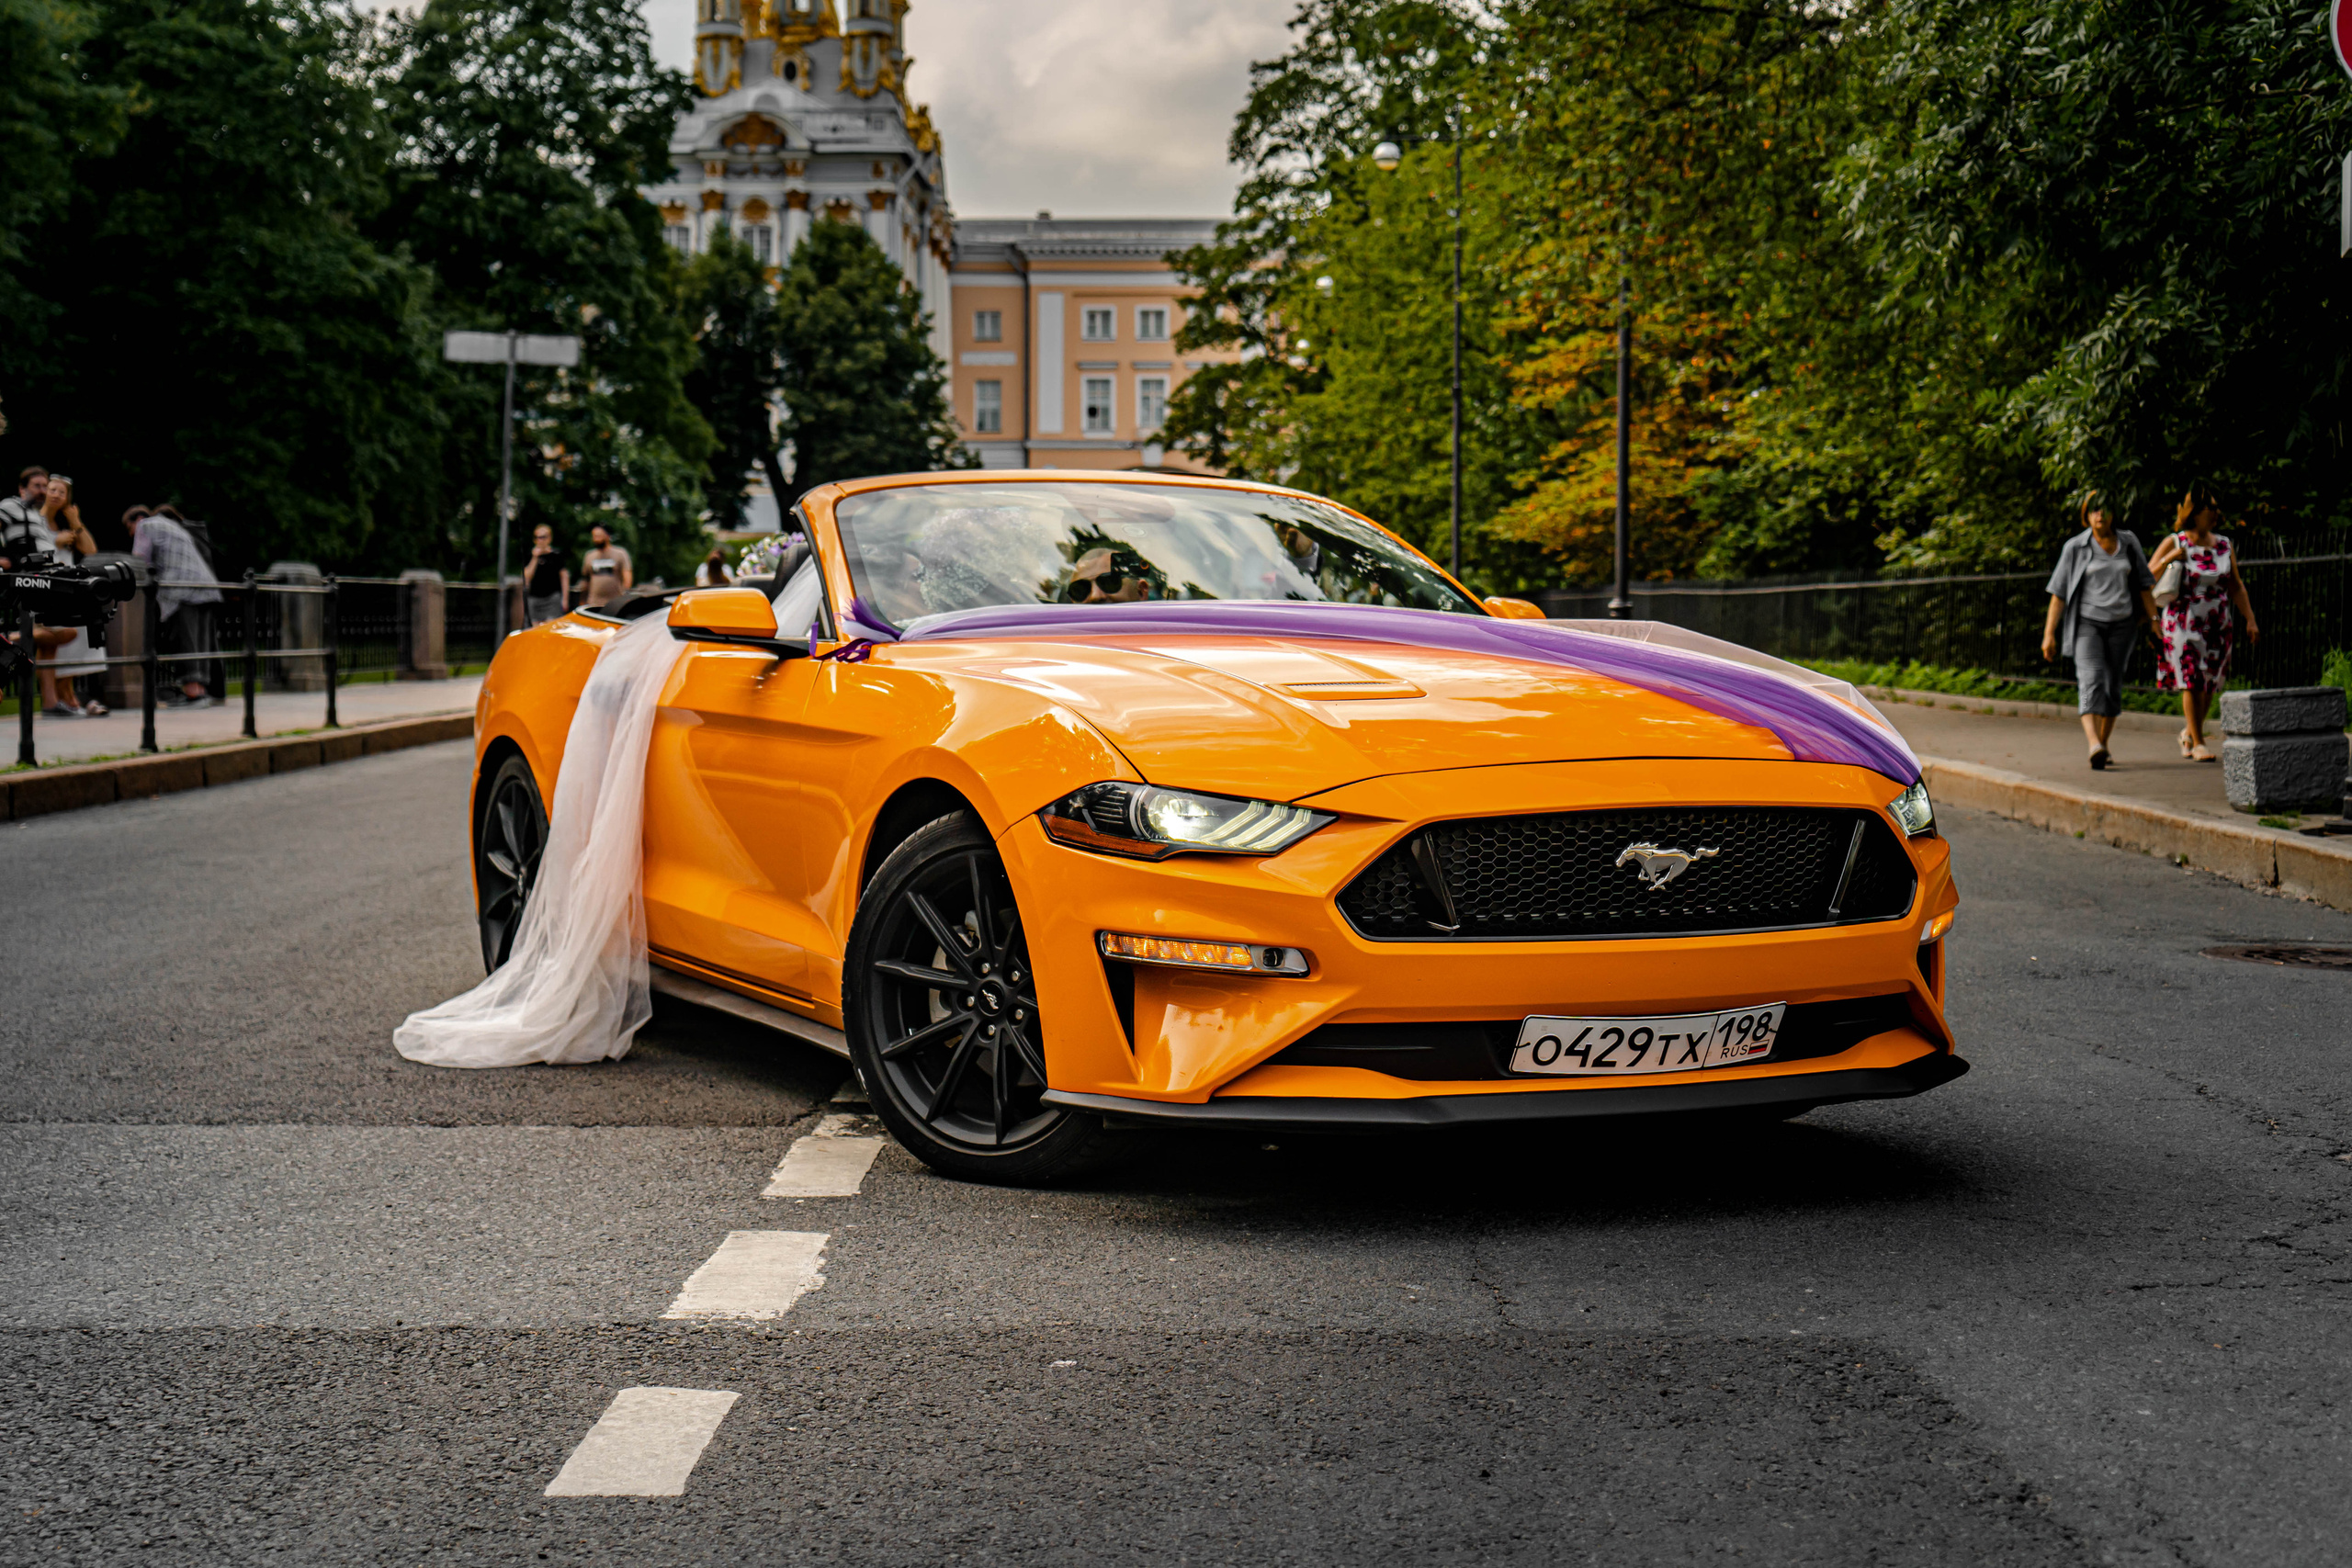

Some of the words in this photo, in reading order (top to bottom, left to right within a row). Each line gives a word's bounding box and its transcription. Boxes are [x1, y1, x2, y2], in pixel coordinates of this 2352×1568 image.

[15, 577, 51, 590] RONIN
[1718, 1011, 1773, 1048] 198
[1720, 1044, 1748, 1059] RUS
